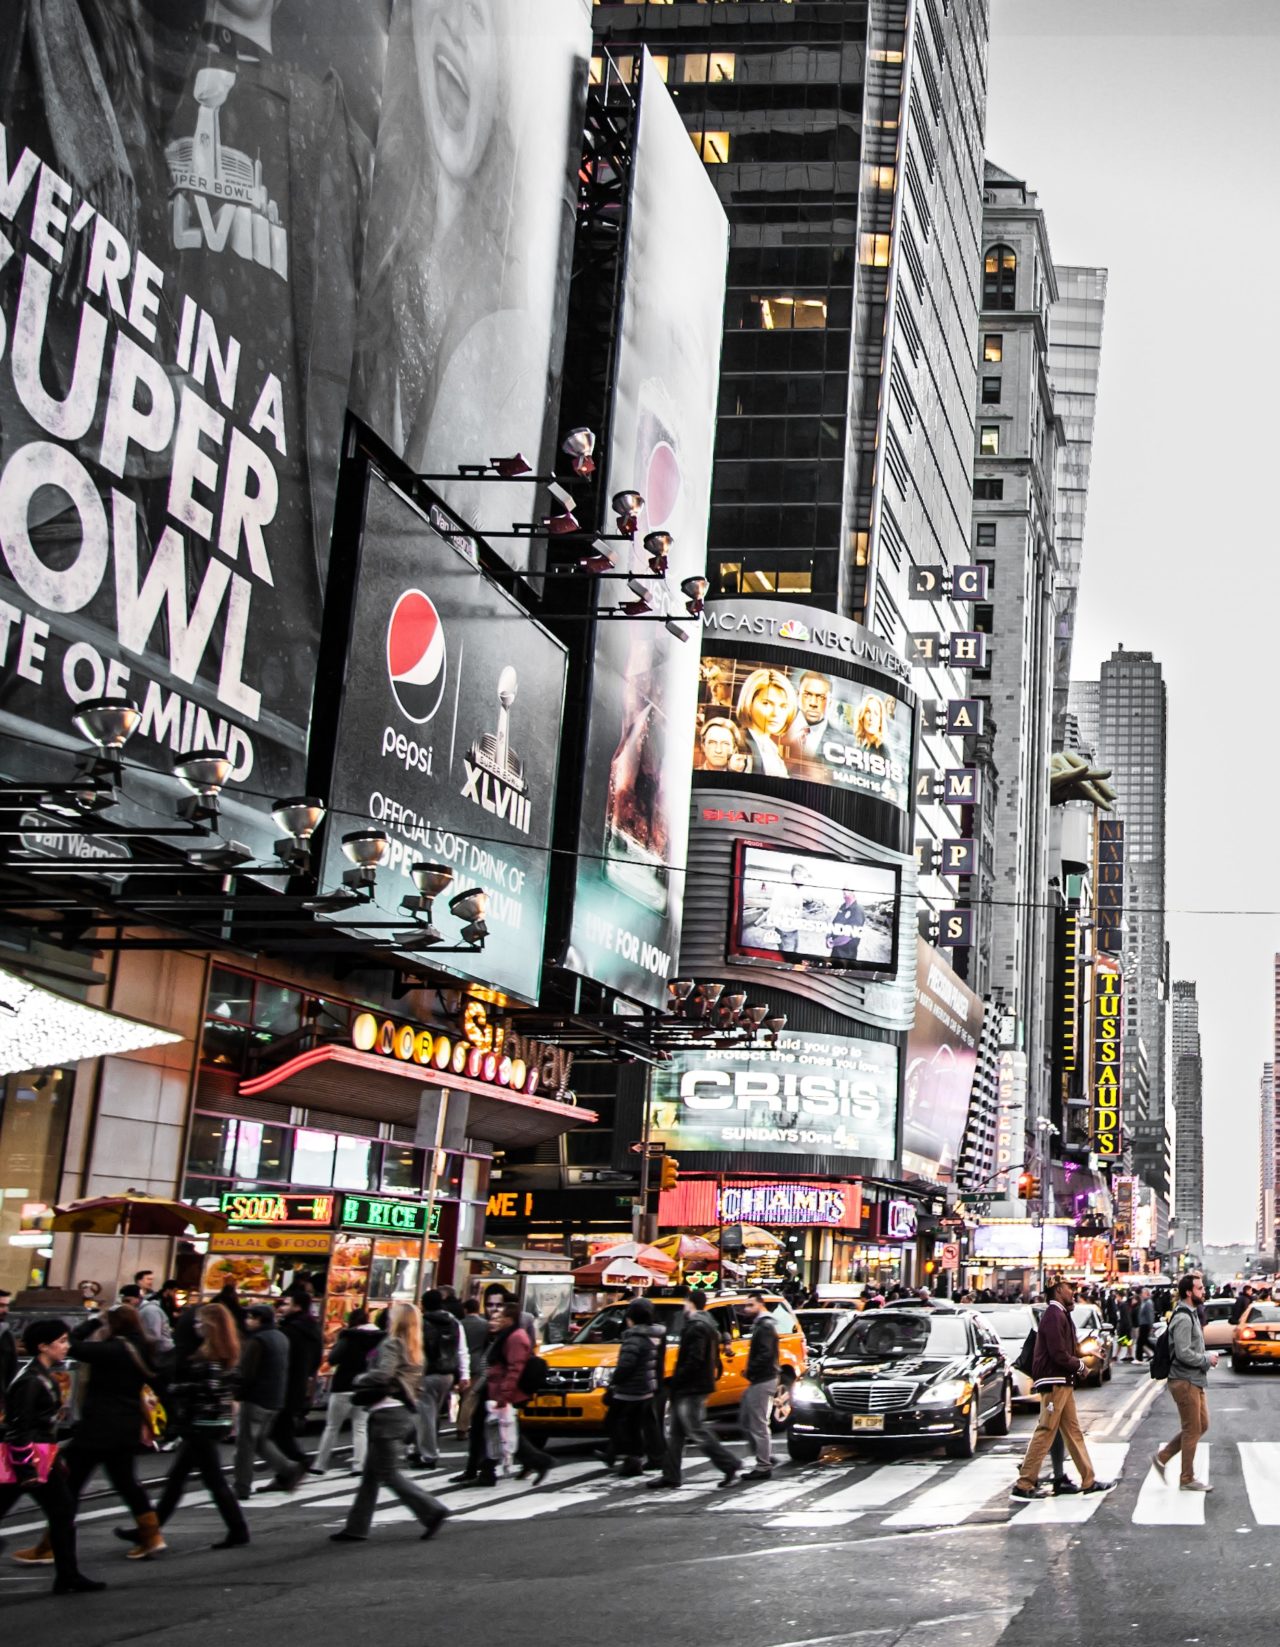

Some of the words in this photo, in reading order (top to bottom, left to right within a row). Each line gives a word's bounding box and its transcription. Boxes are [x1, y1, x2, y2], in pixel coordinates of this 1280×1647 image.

[214, 185, 253, 201] BOWL
[176, 294, 241, 410] IN
[249, 372, 287, 456] A
[381, 726, 433, 776] pepsi
[823, 742, 904, 783] CRISIS
[460, 758, 532, 834] XLVIII
[703, 808, 779, 825] SHARP
[369, 792, 432, 848] OFFICIAL
[434, 826, 469, 866] SOFT
[471, 845, 508, 889] DRINK
[509, 867, 525, 894] OF
[616, 927, 640, 964] FOR
[640, 941, 671, 979] NOW
[706, 1050, 766, 1062] protect
[771, 1050, 795, 1063] the
[799, 1055, 833, 1067] ones
[804, 1040, 829, 1057] you
[680, 1069, 881, 1121] CRISIS
[721, 1127, 799, 1144] SUNDAYS
[367, 1202, 418, 1228] RICE
[722, 1187, 846, 1223] CHAMPS
[212, 1237, 263, 1248] HALAL
[285, 1239, 329, 1249] FOOD
